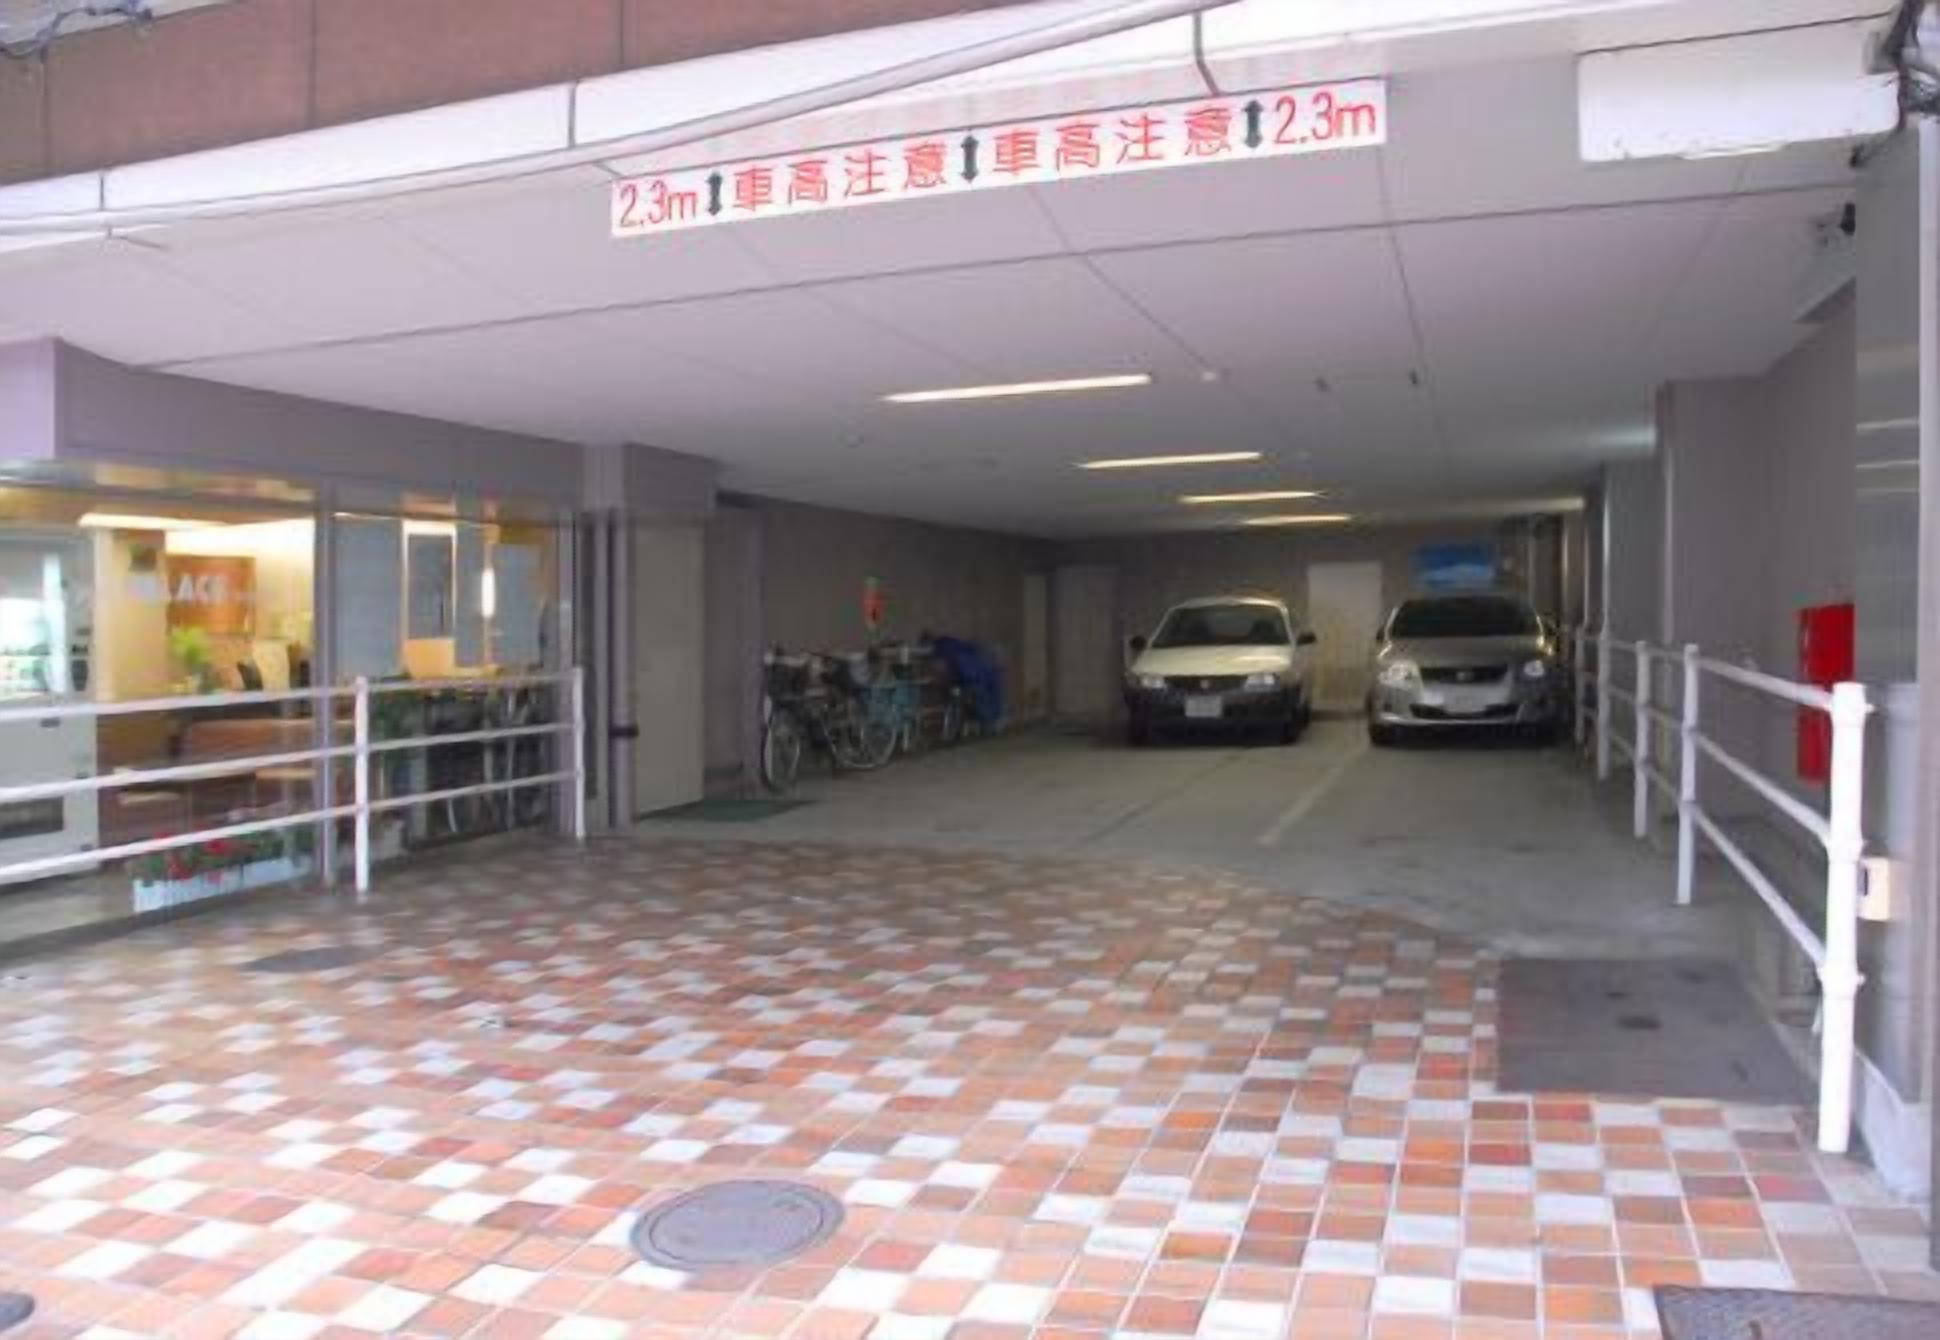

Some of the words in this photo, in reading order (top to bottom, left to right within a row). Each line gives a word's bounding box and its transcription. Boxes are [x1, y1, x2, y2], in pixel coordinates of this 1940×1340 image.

[618, 178, 698, 228] 2.3m
[732, 139, 948, 212] 車高注意
[992, 106, 1233, 176] 車高注意
[1273, 91, 1376, 146] 2.3m
